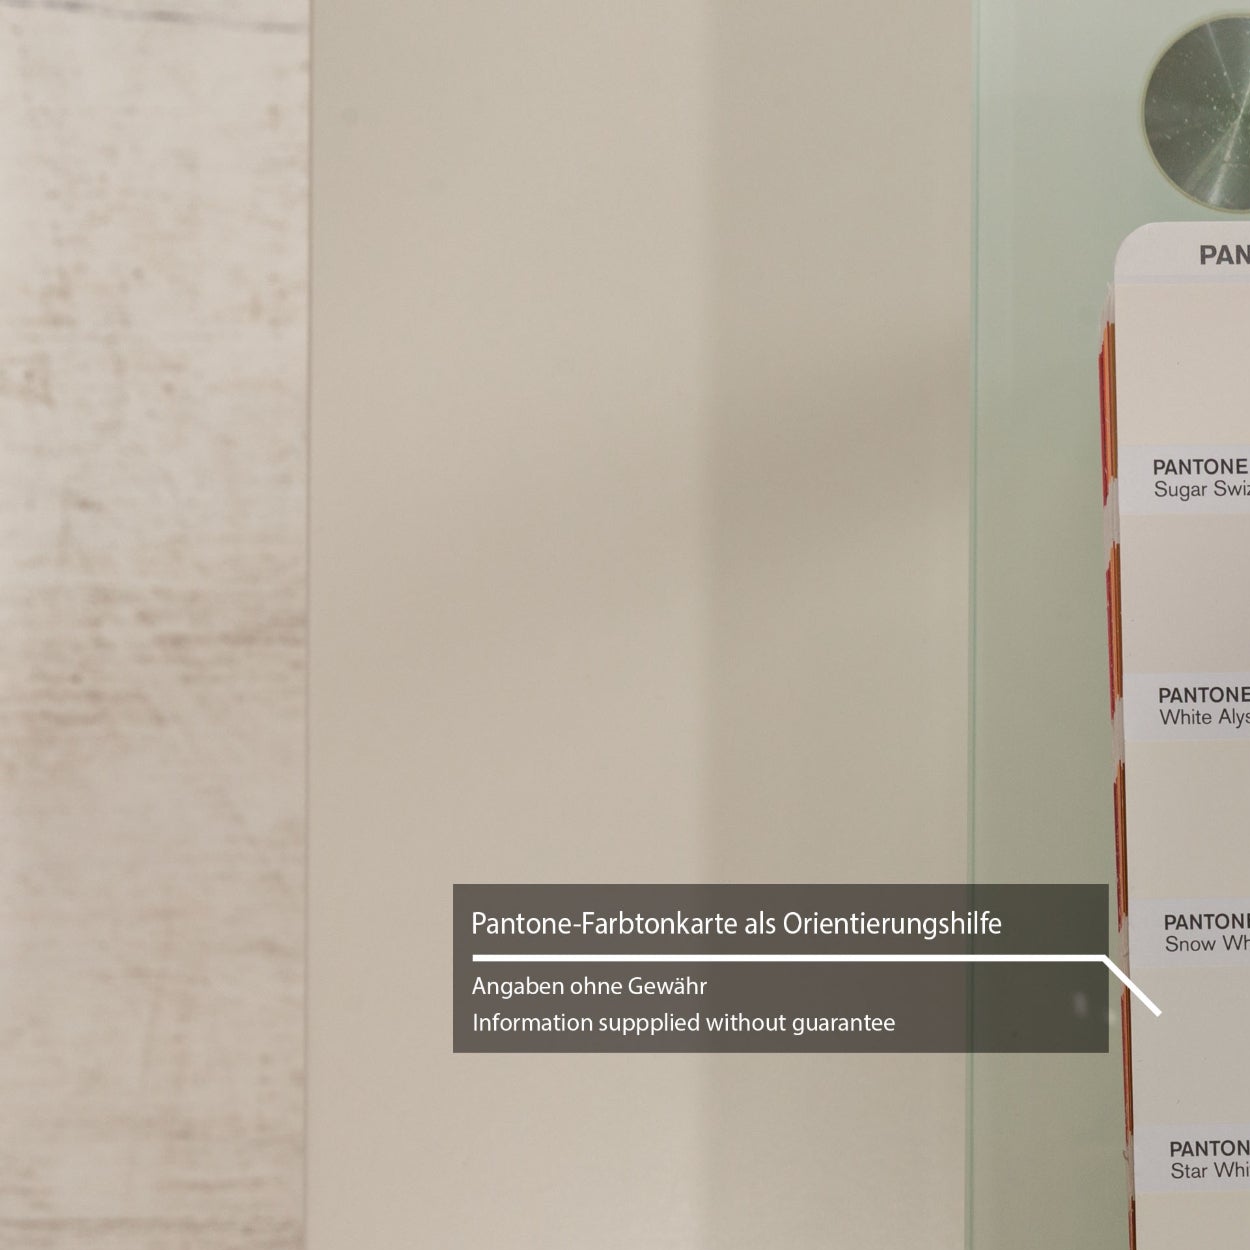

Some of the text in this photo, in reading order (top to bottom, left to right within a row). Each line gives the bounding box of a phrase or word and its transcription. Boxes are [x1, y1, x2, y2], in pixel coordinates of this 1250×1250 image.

[1153, 458, 1249, 476] PANTONE
[1154, 480, 1208, 502] Sugar
[1159, 708, 1213, 726] White
[1165, 935, 1217, 953] Snow
[1170, 1162, 1208, 1180] Star
